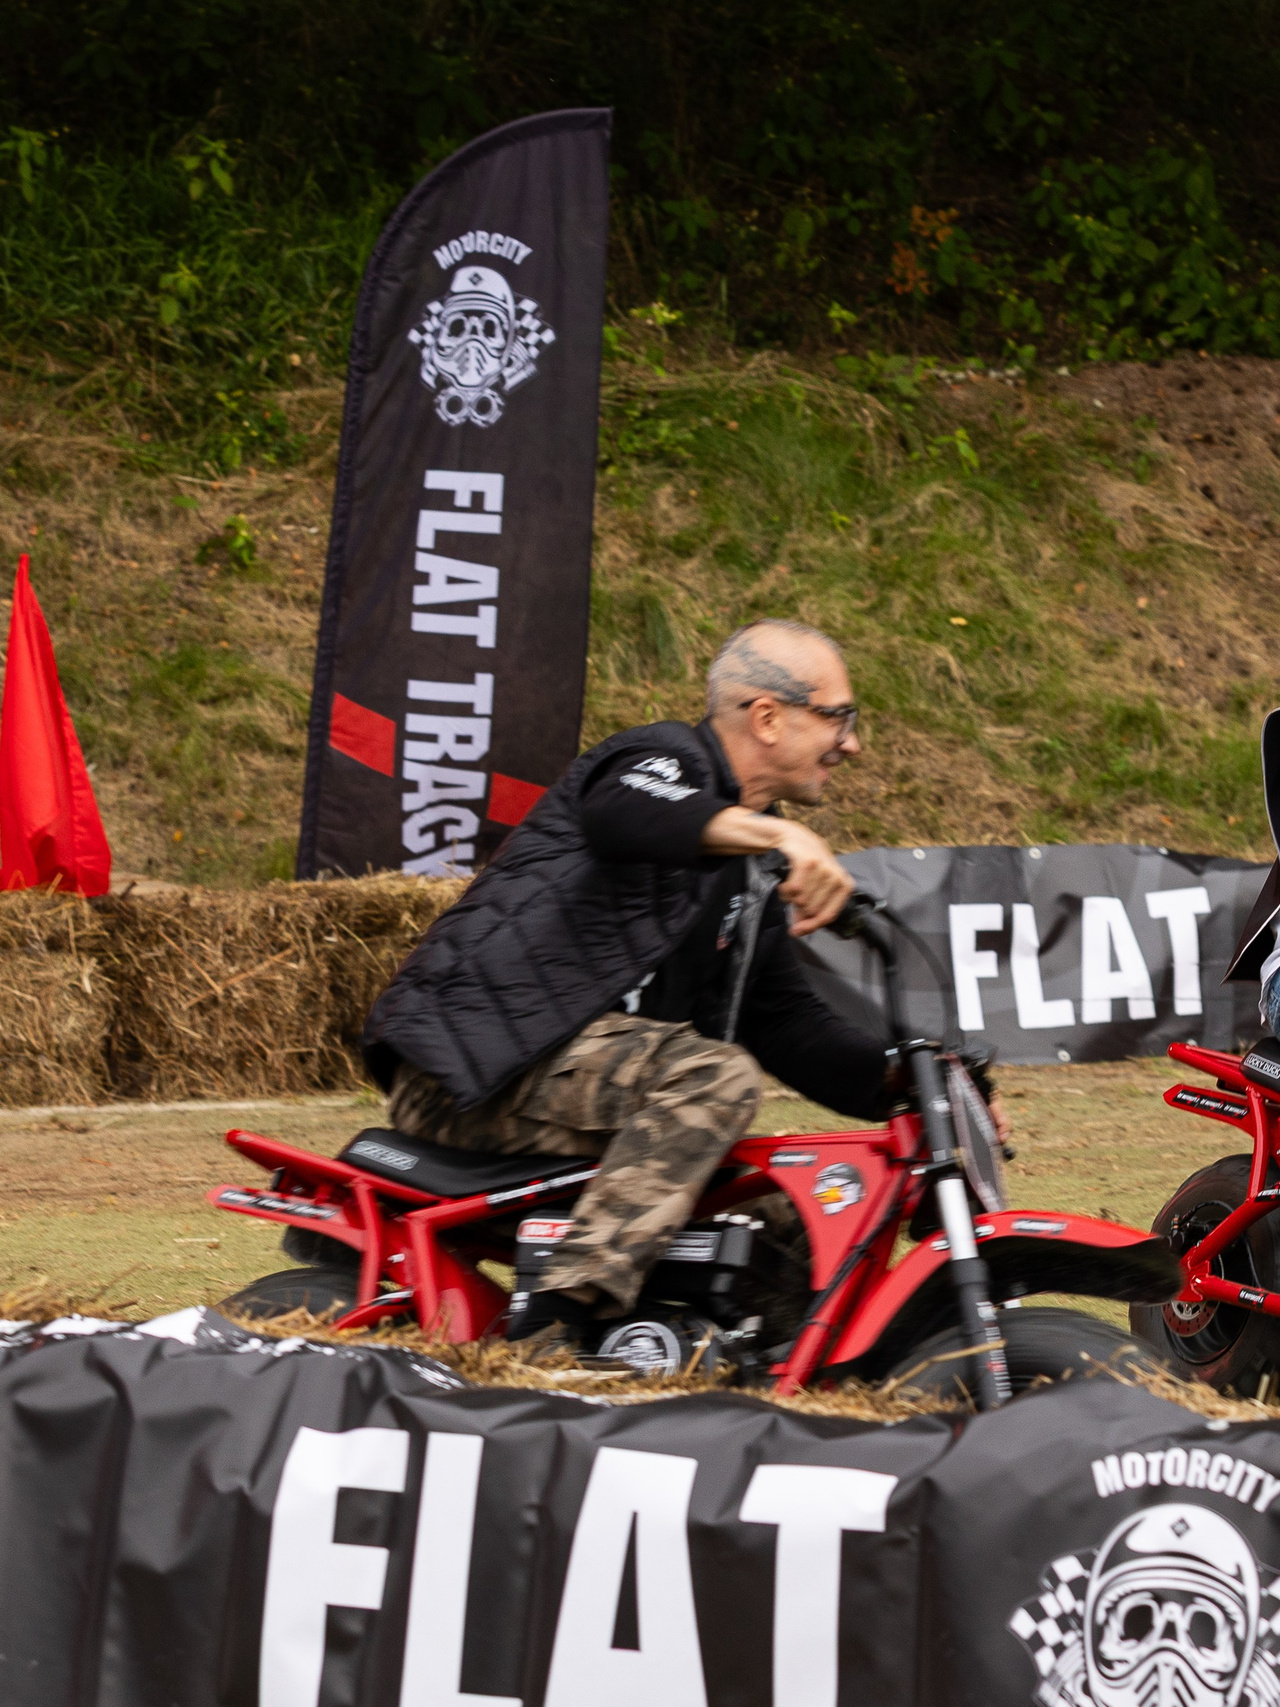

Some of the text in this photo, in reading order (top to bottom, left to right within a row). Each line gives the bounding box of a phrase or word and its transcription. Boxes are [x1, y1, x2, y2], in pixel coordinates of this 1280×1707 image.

[402, 470, 504, 877] FLAT TRACK
[949, 887, 1211, 1031] FLAT
[258, 1426, 899, 1707] FLAT
